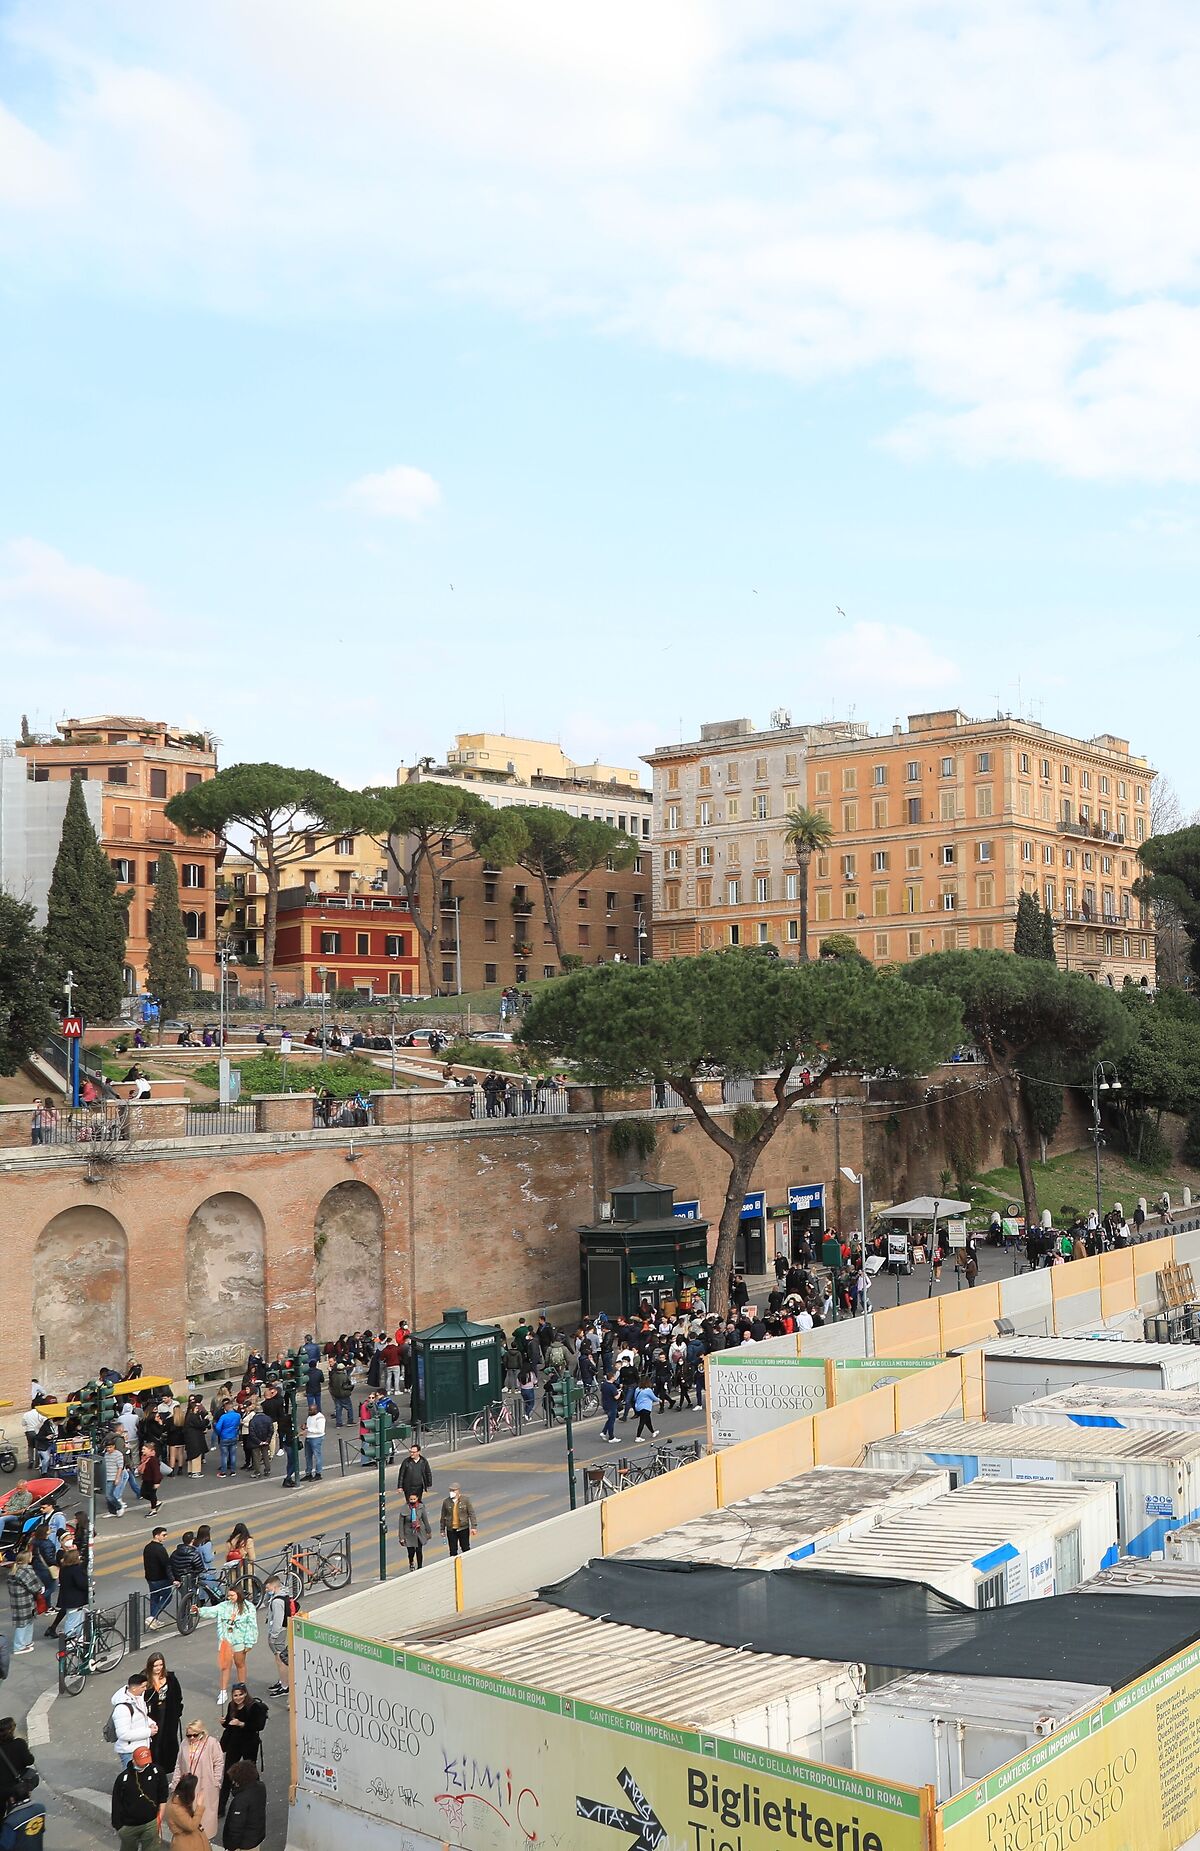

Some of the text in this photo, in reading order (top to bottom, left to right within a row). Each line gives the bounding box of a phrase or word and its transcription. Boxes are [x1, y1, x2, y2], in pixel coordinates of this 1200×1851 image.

[65, 1022, 80, 1034] M
[789, 1194, 813, 1204] Colosseo
[717, 1383, 825, 1398] ARCHEOLOGICO
[718, 1395, 813, 1410] DEL COLOSSEO
[1030, 1556, 1052, 1579] TREVI
[314, 1629, 383, 1658] CANTIERE FORI IMPERIALI
[417, 1661, 434, 1676] LINEA
[440, 1667, 462, 1683] DELLA
[462, 1674, 517, 1699] METROPOLITANA
[517, 1689, 526, 1702] DI
[526, 1691, 546, 1706] ROMA
[1113, 1694, 1132, 1714] LINEA
[1137, 1680, 1155, 1700] DELLA
[1154, 1653, 1199, 1689] METROPOLITANA
[304, 1675, 435, 1738] ARCHEOLOGICO
[1156, 1691, 1181, 1713] Benvenuti
[1156, 1707, 1171, 1722] Parco
[304, 1697, 333, 1728] DEL
[335, 1708, 421, 1757] COLOSSEO
[589, 1709, 684, 1745] CANTIERE FORI IMPERIALI
[1157, 1713, 1190, 1743] Questi luoghi
[1163, 1726, 1189, 1747] accolgono
[998, 1727, 1080, 1789] CANTIERE FORI IMPERIALI
[1164, 1741, 1179, 1758] 2000
[1159, 1754, 1175, 1771] strade
[1159, 1764, 1176, 1781] hanno
[733, 1747, 903, 1809] LINEA C DELLA METROPOLITANA DI ROMA
[1164, 1772, 1181, 1788] tempo
[1160, 1779, 1183, 1801] chiedono
[1161, 1790, 1183, 1811] aiutateci
[687, 1767, 883, 1851] Biglietterie
[1162, 1789, 1198, 1820] accompagnarli
